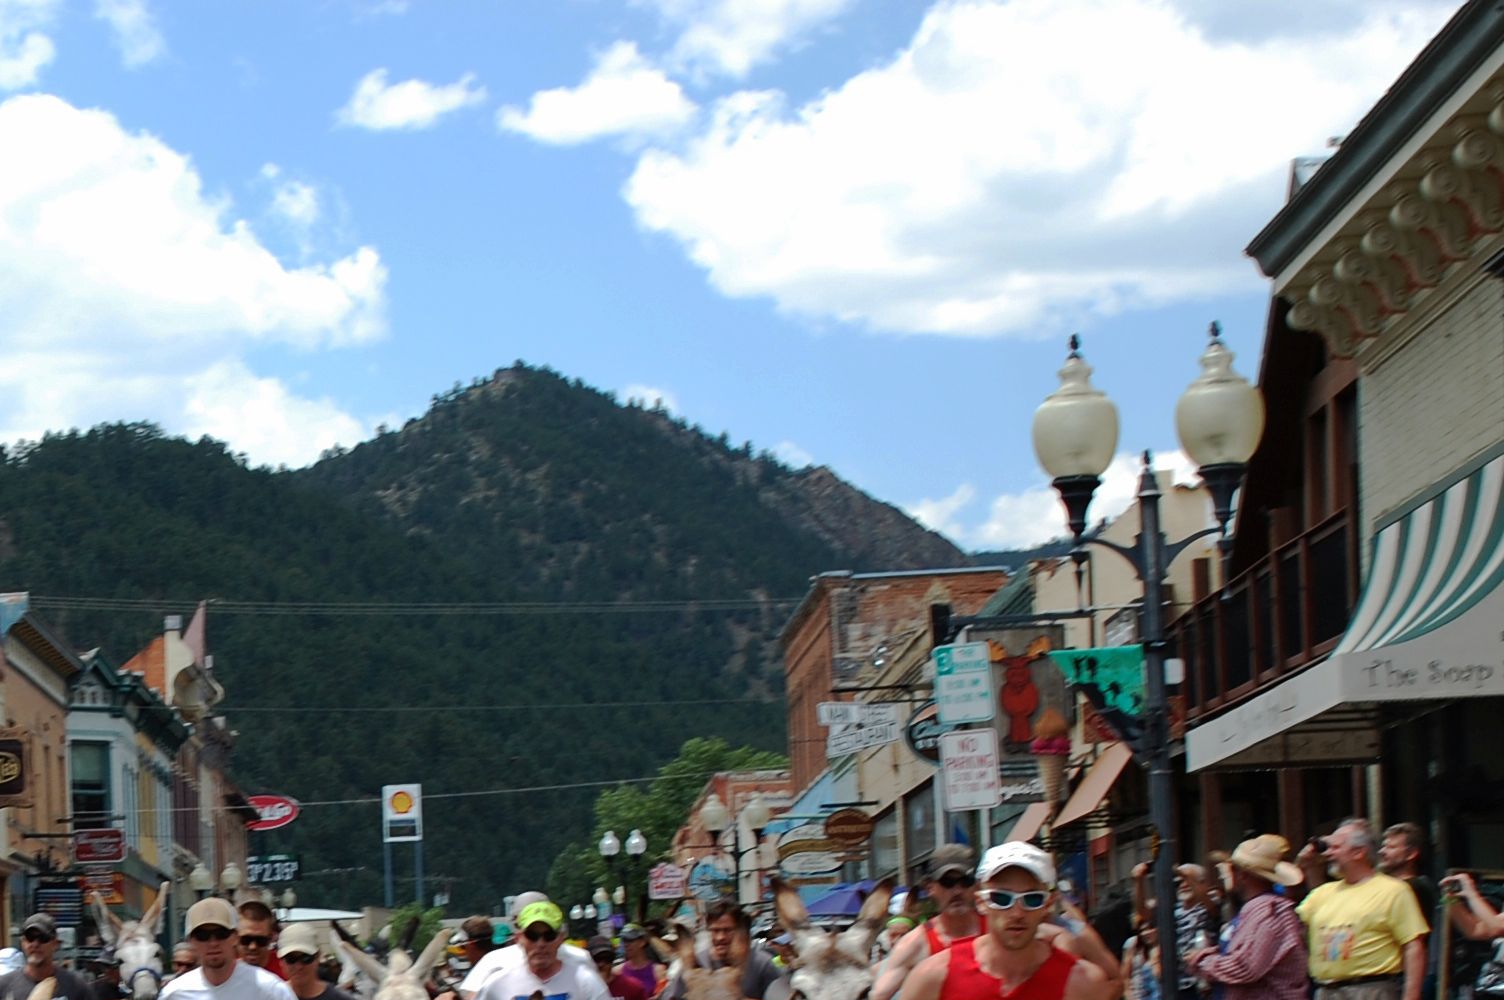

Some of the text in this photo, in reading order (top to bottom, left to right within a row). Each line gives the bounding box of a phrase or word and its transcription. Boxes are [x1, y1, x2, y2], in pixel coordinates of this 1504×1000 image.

[1361, 659, 1495, 689] The Soap
[959, 737, 977, 753] NO
[943, 753, 993, 769] PARKING
